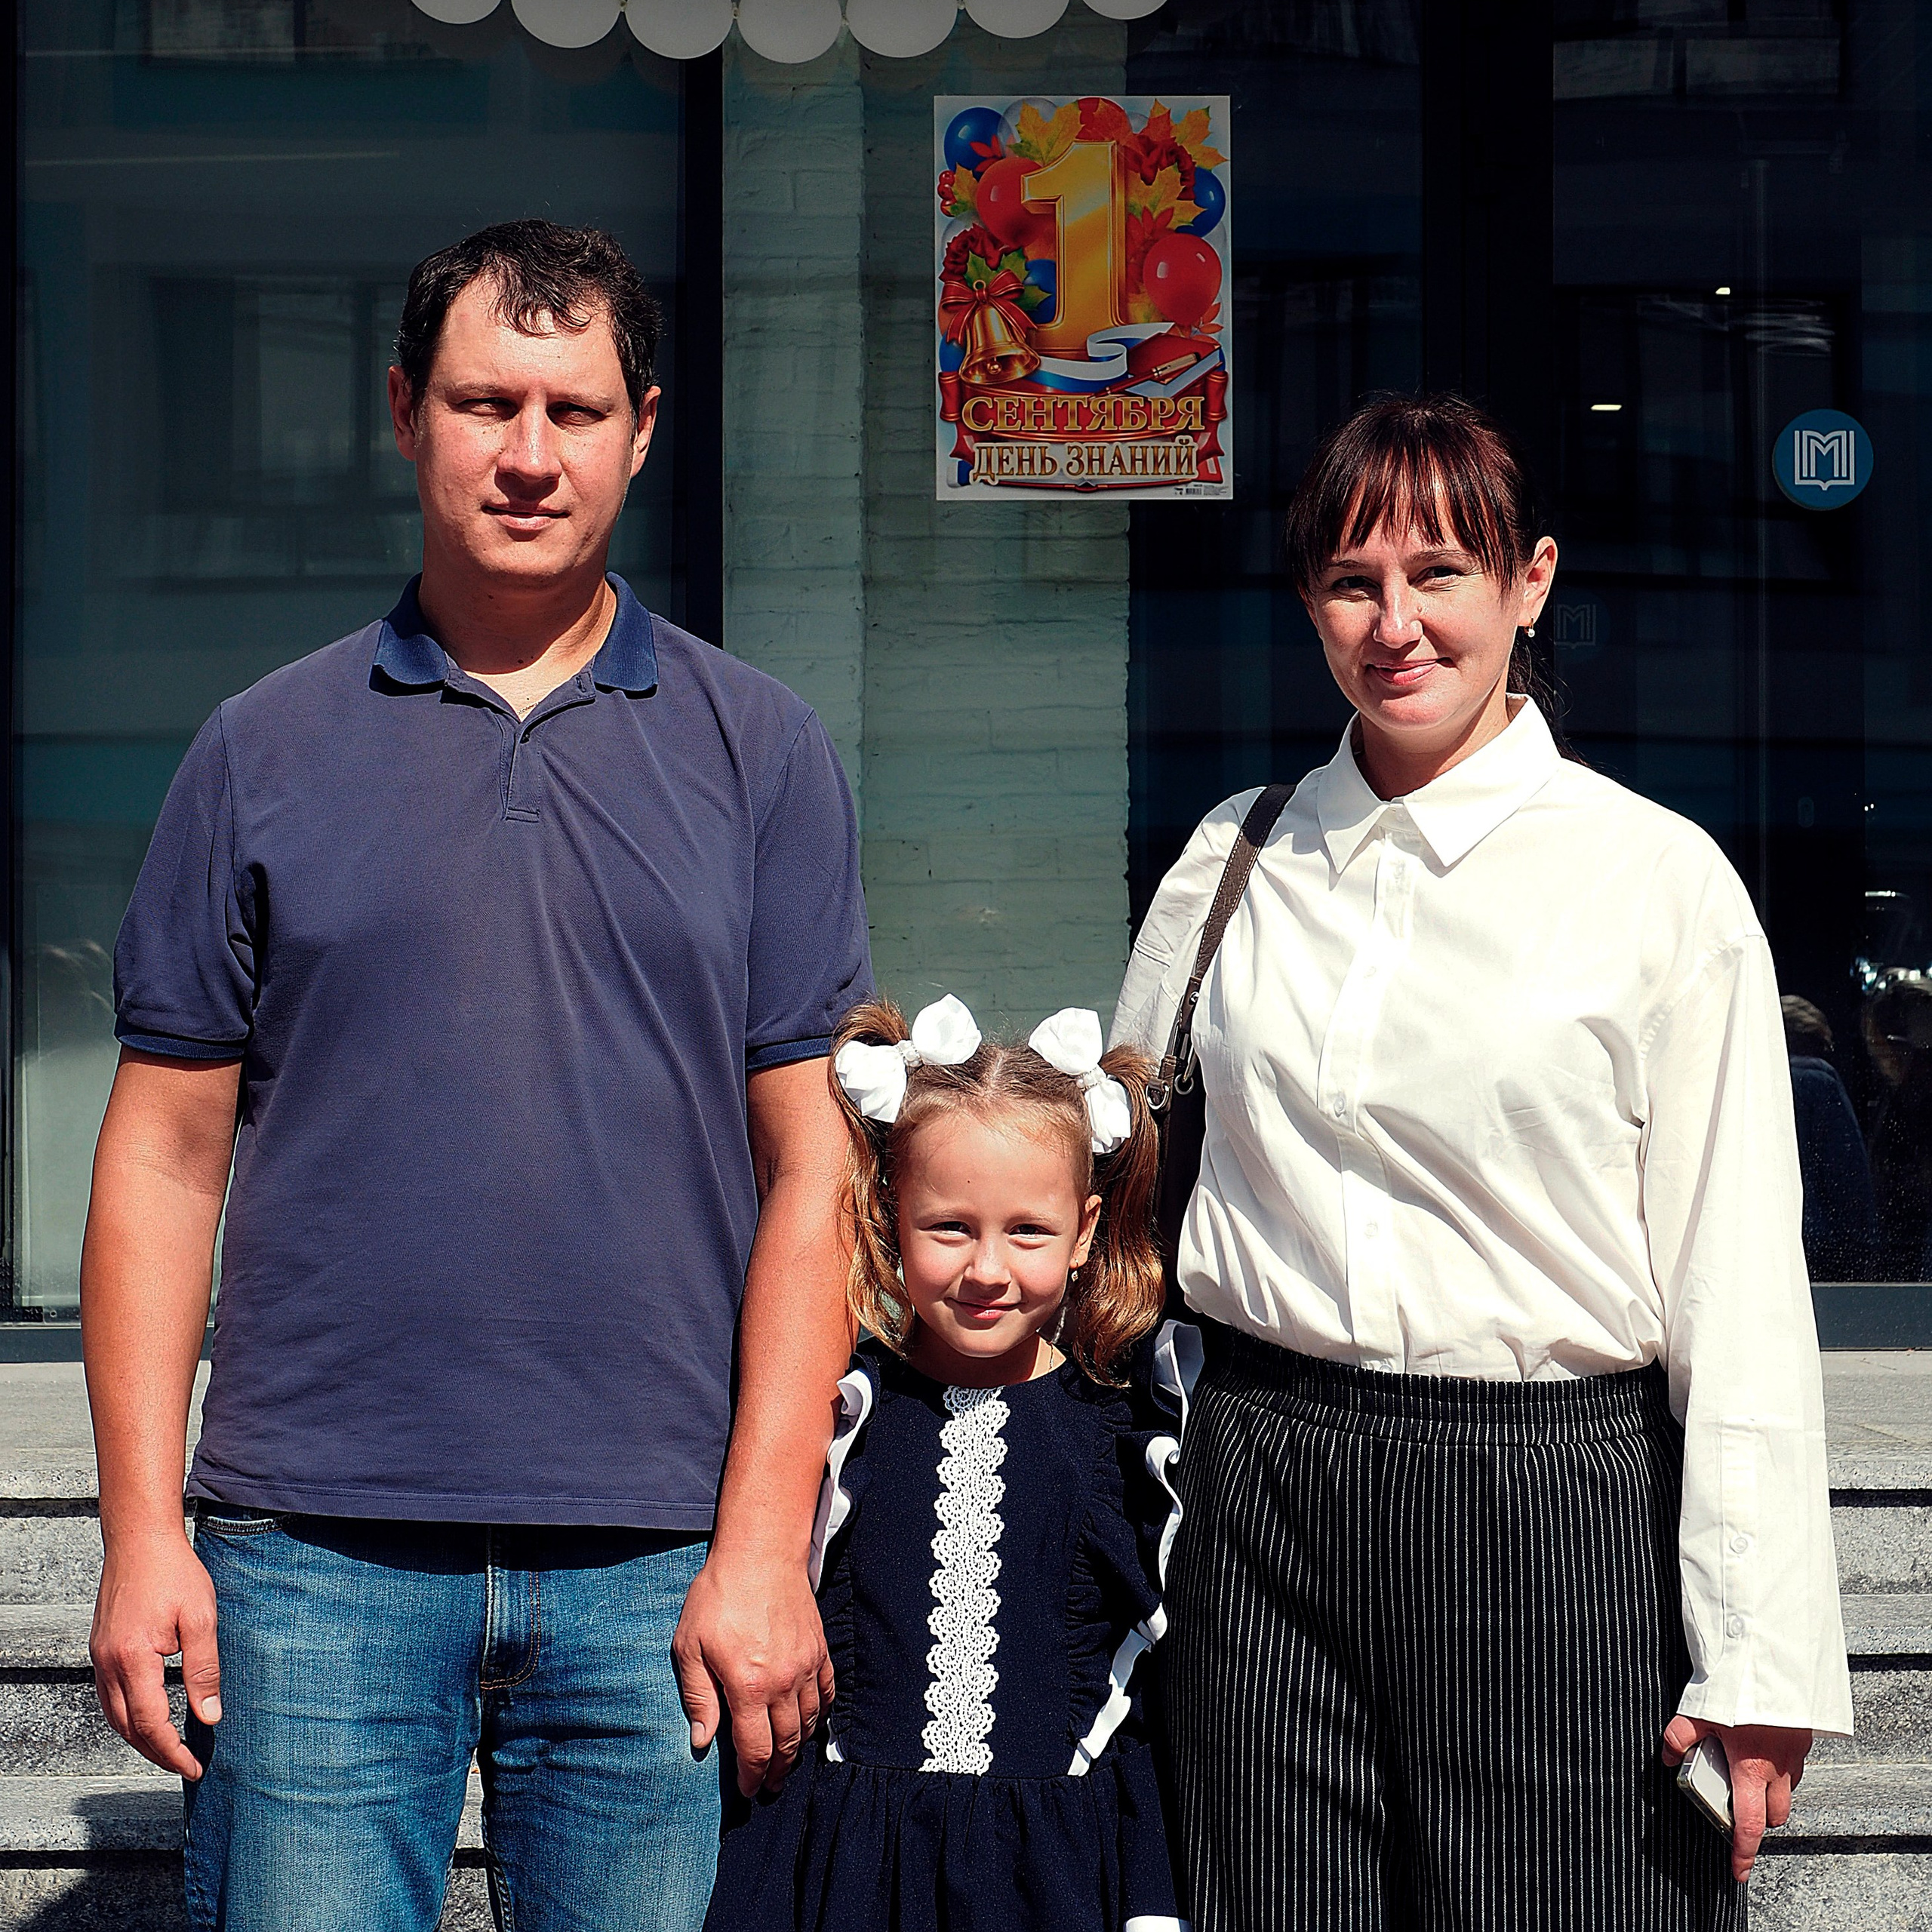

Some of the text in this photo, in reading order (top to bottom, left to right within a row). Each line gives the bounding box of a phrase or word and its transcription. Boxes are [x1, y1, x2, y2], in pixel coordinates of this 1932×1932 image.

[1020, 139, 1129, 353] 1
[961, 395, 1205, 431] СЕНТЯБРЯ
[972, 438, 1197, 481] ДЕНЬ ЗНАНИЙ
